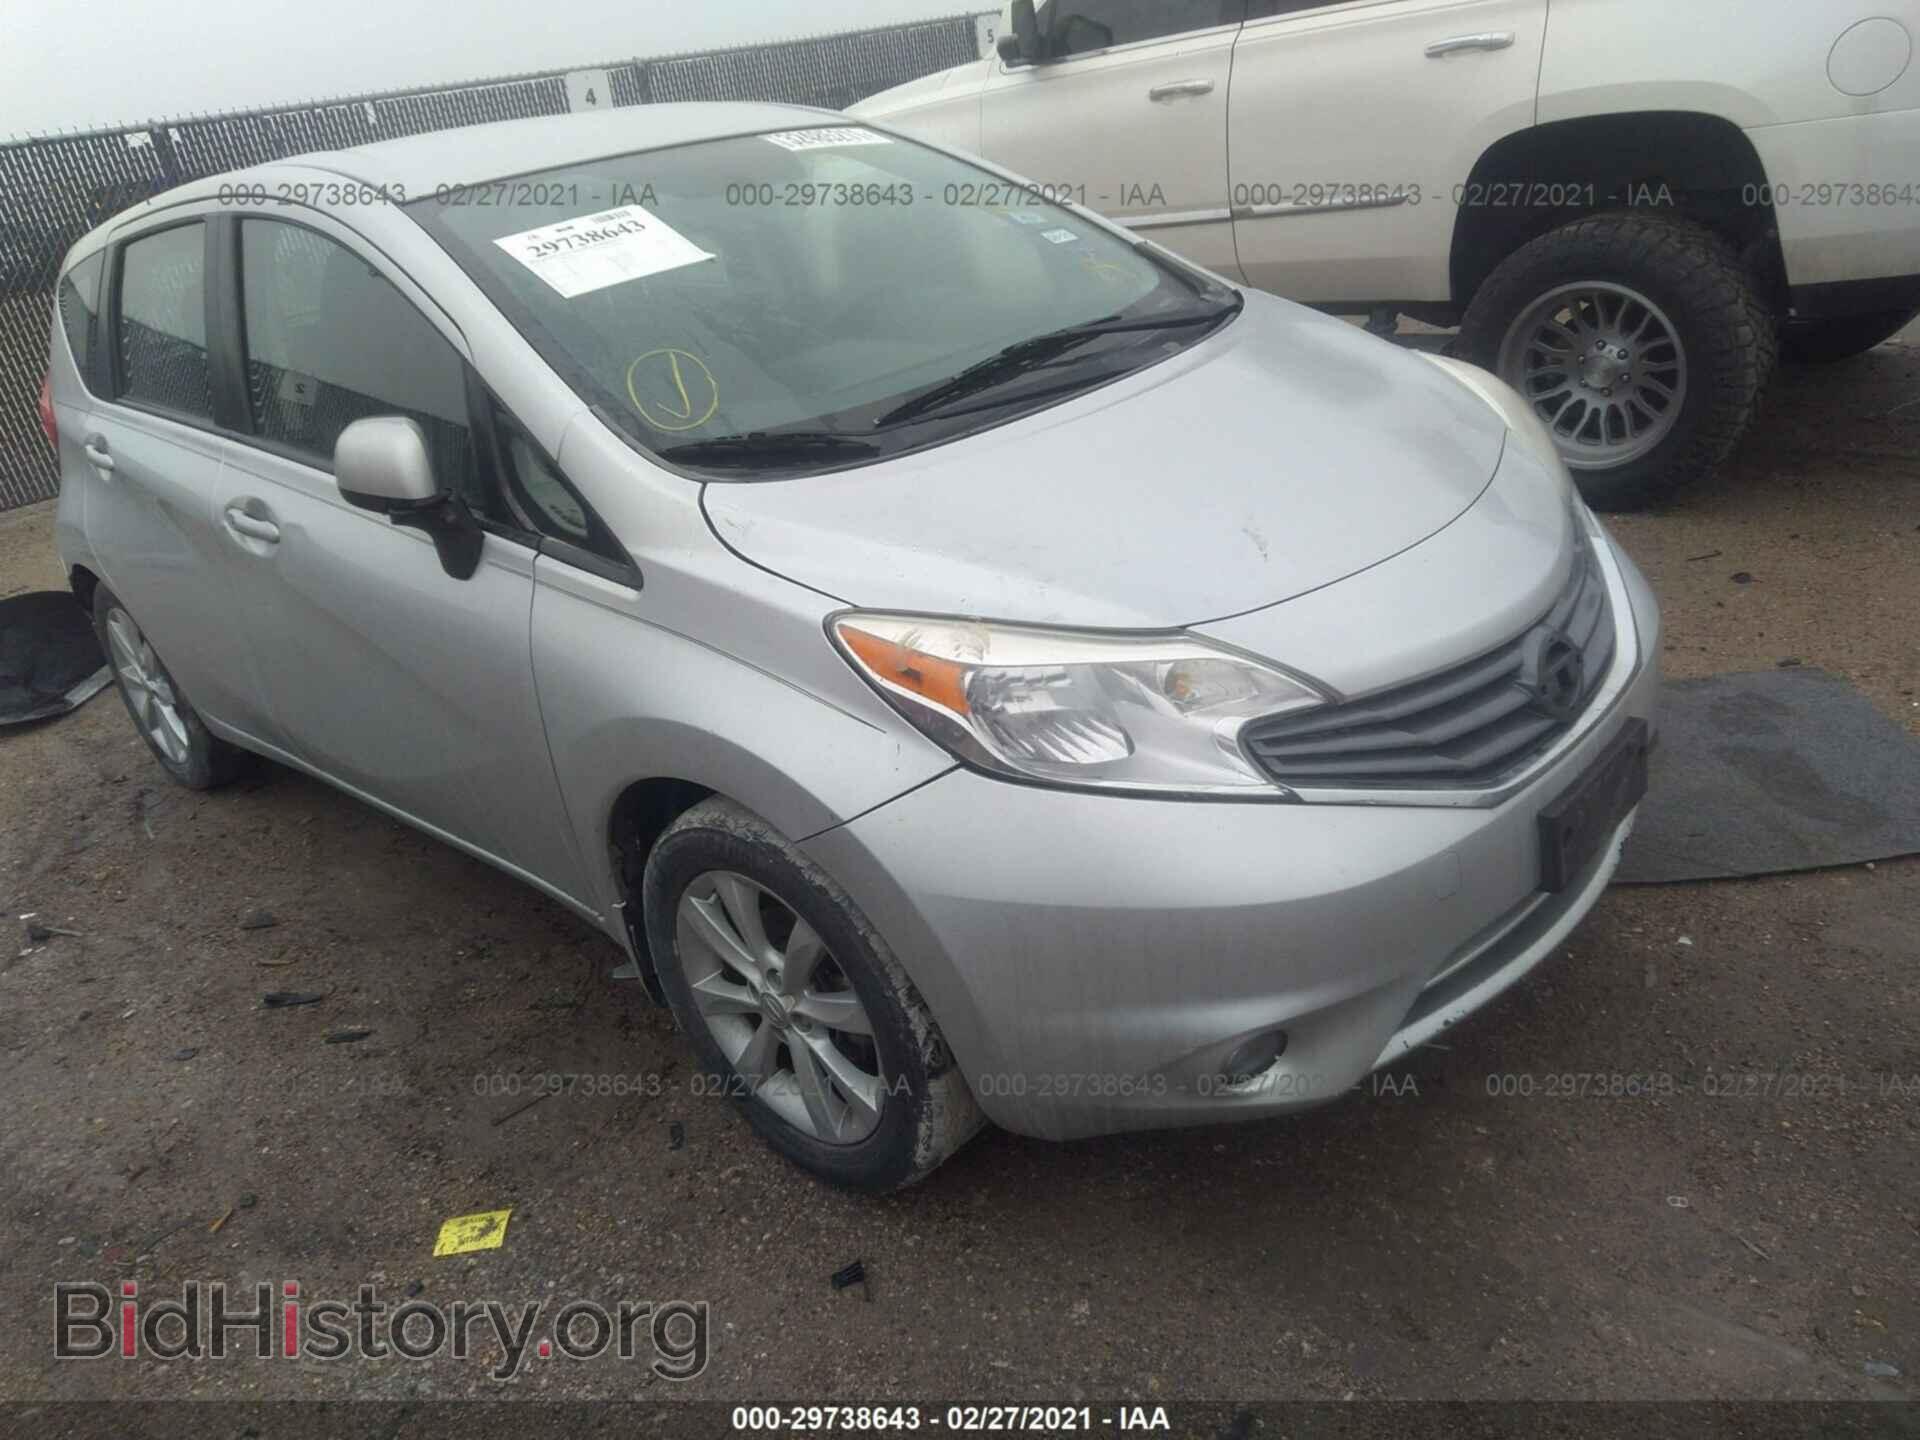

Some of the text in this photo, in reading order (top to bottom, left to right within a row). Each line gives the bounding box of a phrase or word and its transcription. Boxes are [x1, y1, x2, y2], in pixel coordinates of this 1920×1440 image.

[986, 28, 995, 44] 5
[585, 87, 597, 106] 4
[526, 219, 647, 258] 29738643
